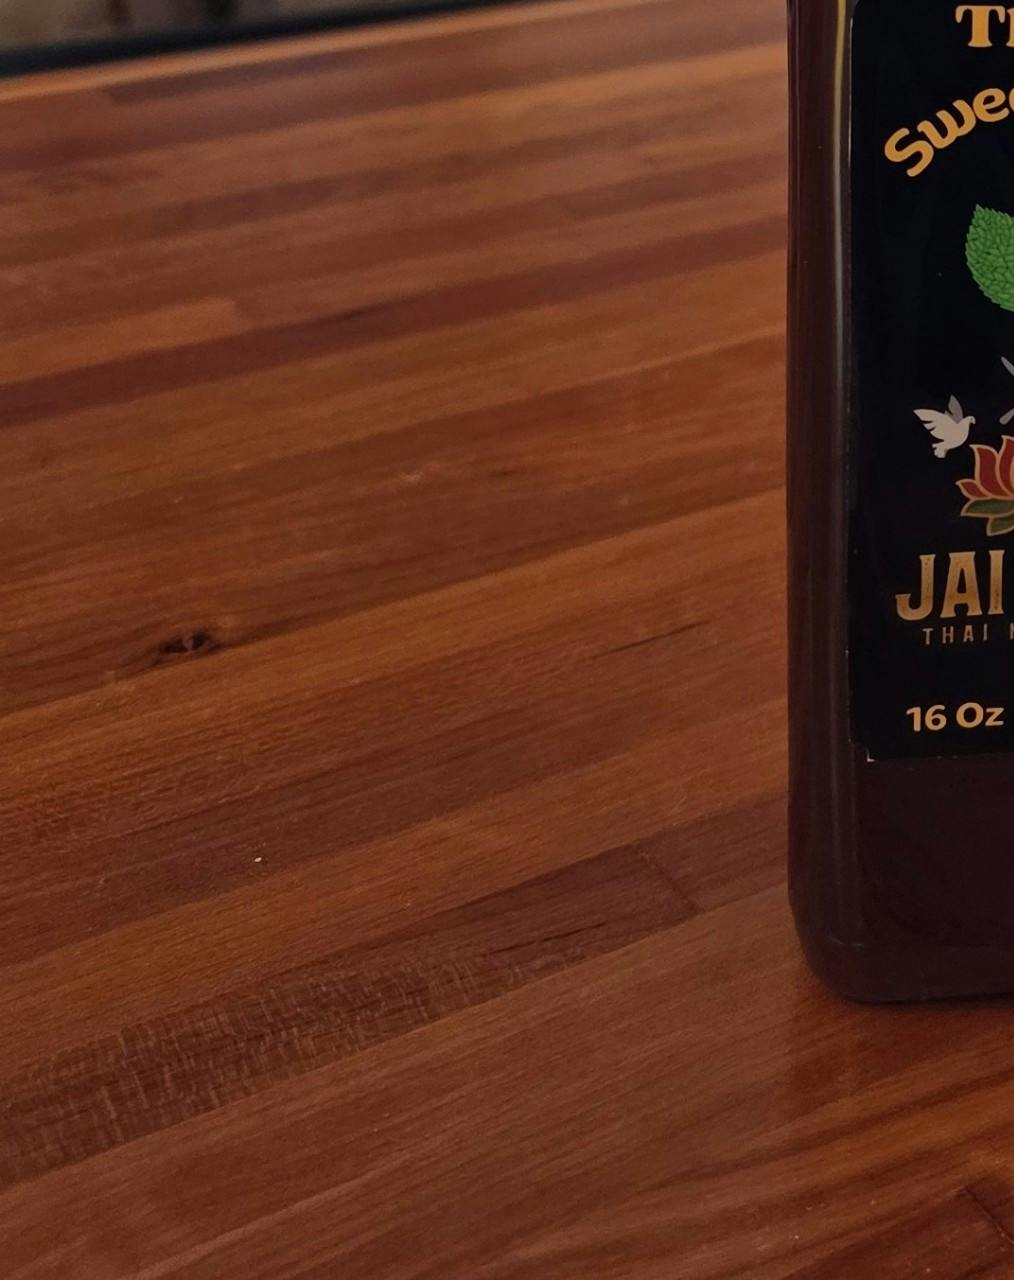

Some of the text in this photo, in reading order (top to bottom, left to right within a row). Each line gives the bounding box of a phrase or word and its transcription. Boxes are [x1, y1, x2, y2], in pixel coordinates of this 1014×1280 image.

[895, 549, 1005, 621] JAI
[922, 624, 989, 645] THAI
[906, 702, 1004, 732] 16 Oz
